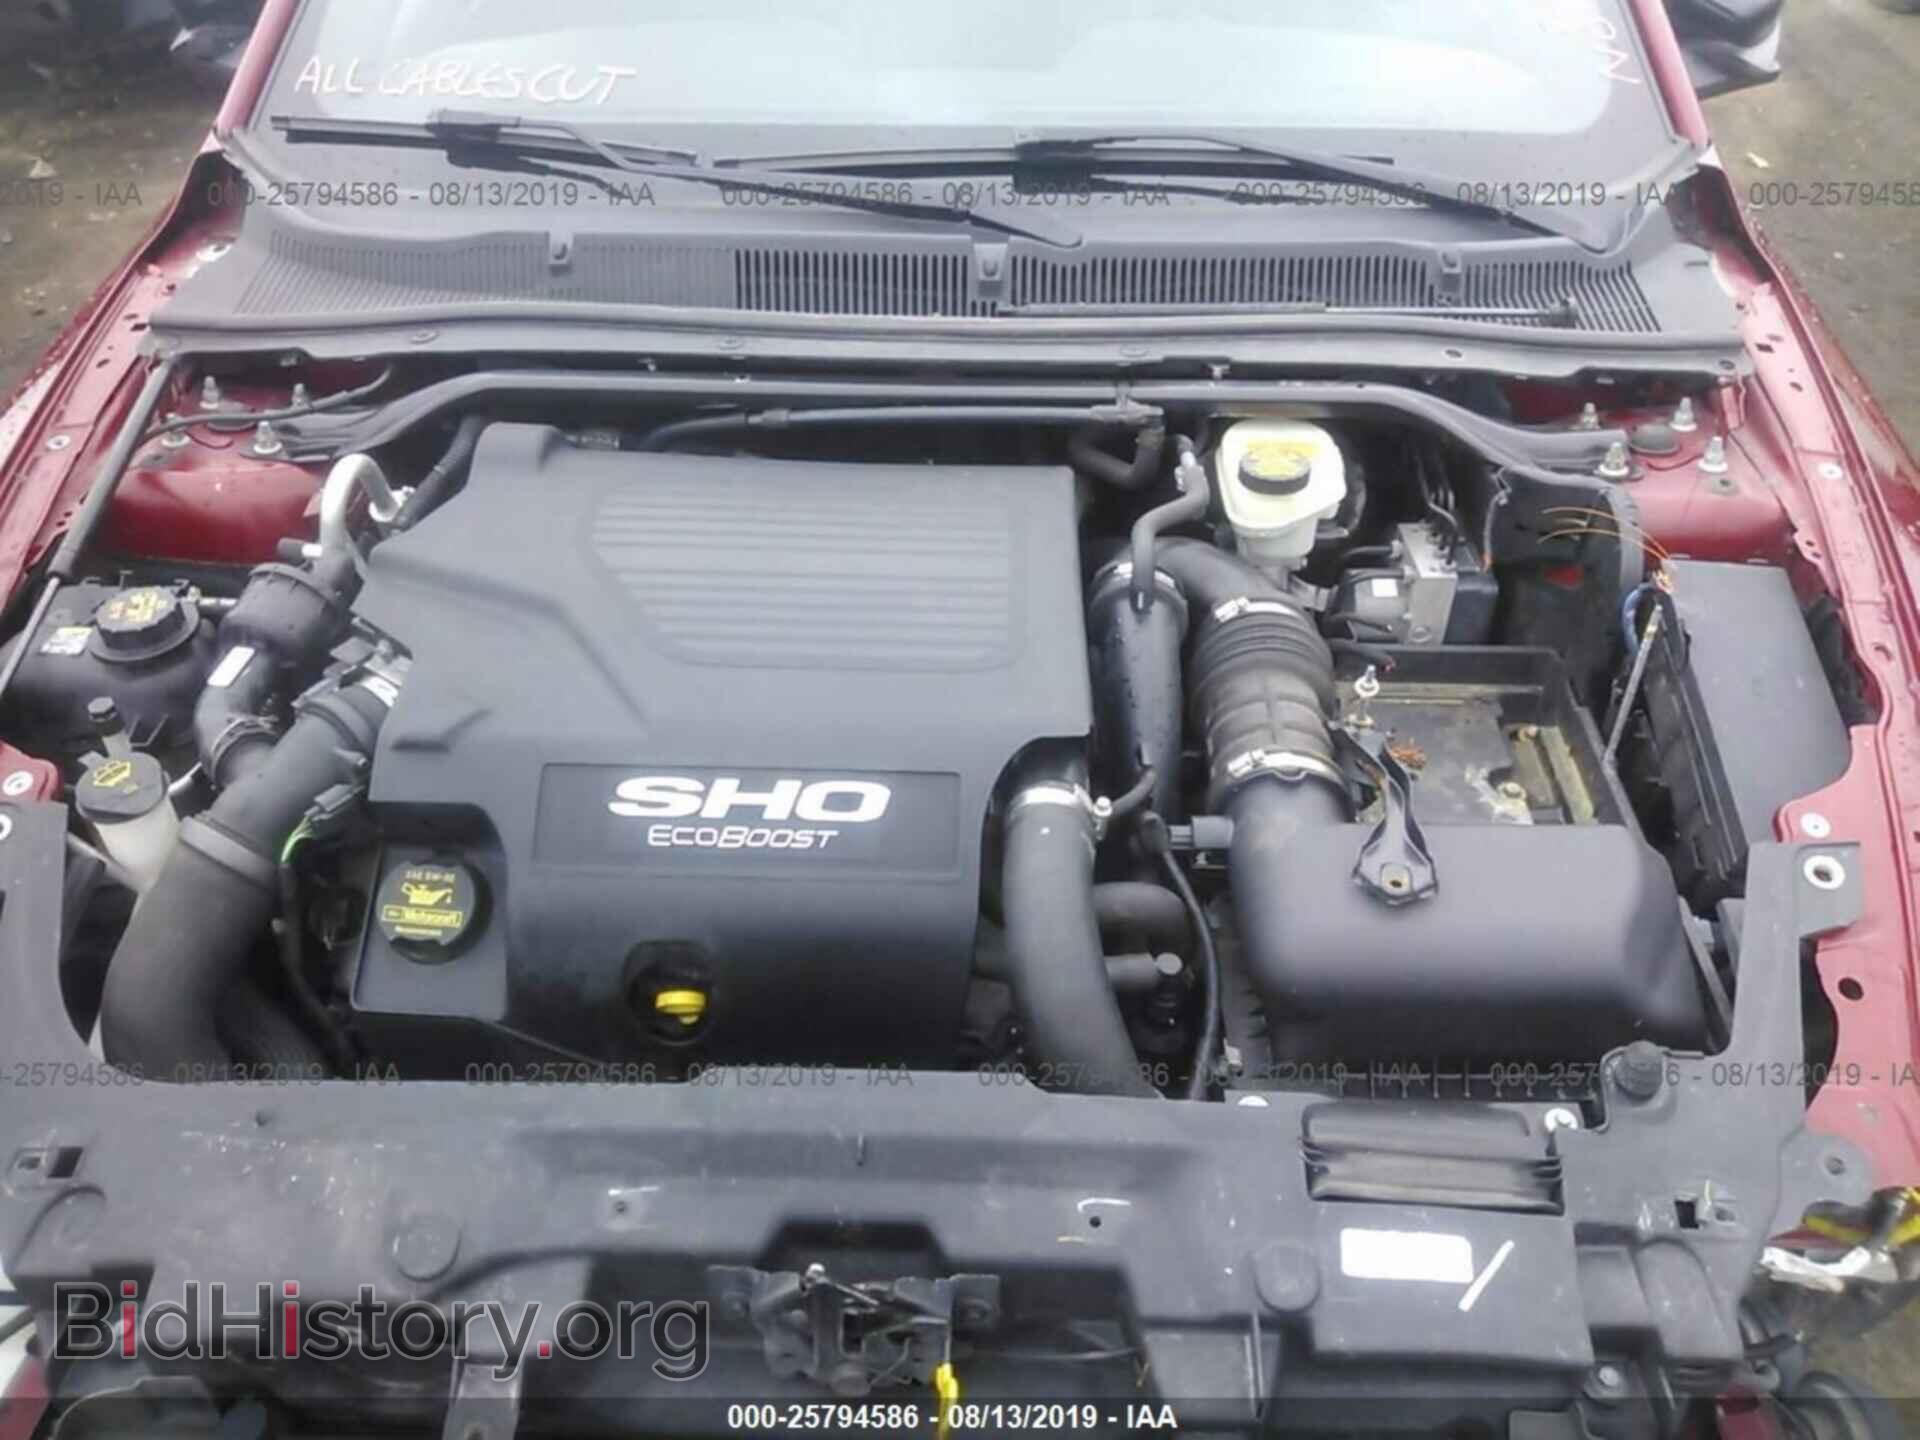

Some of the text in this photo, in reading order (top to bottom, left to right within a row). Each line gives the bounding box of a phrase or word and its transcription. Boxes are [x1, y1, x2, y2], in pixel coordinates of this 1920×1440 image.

[294, 54, 363, 95] ALL
[529, 62, 637, 105] CUT
[608, 776, 892, 822] SHO
